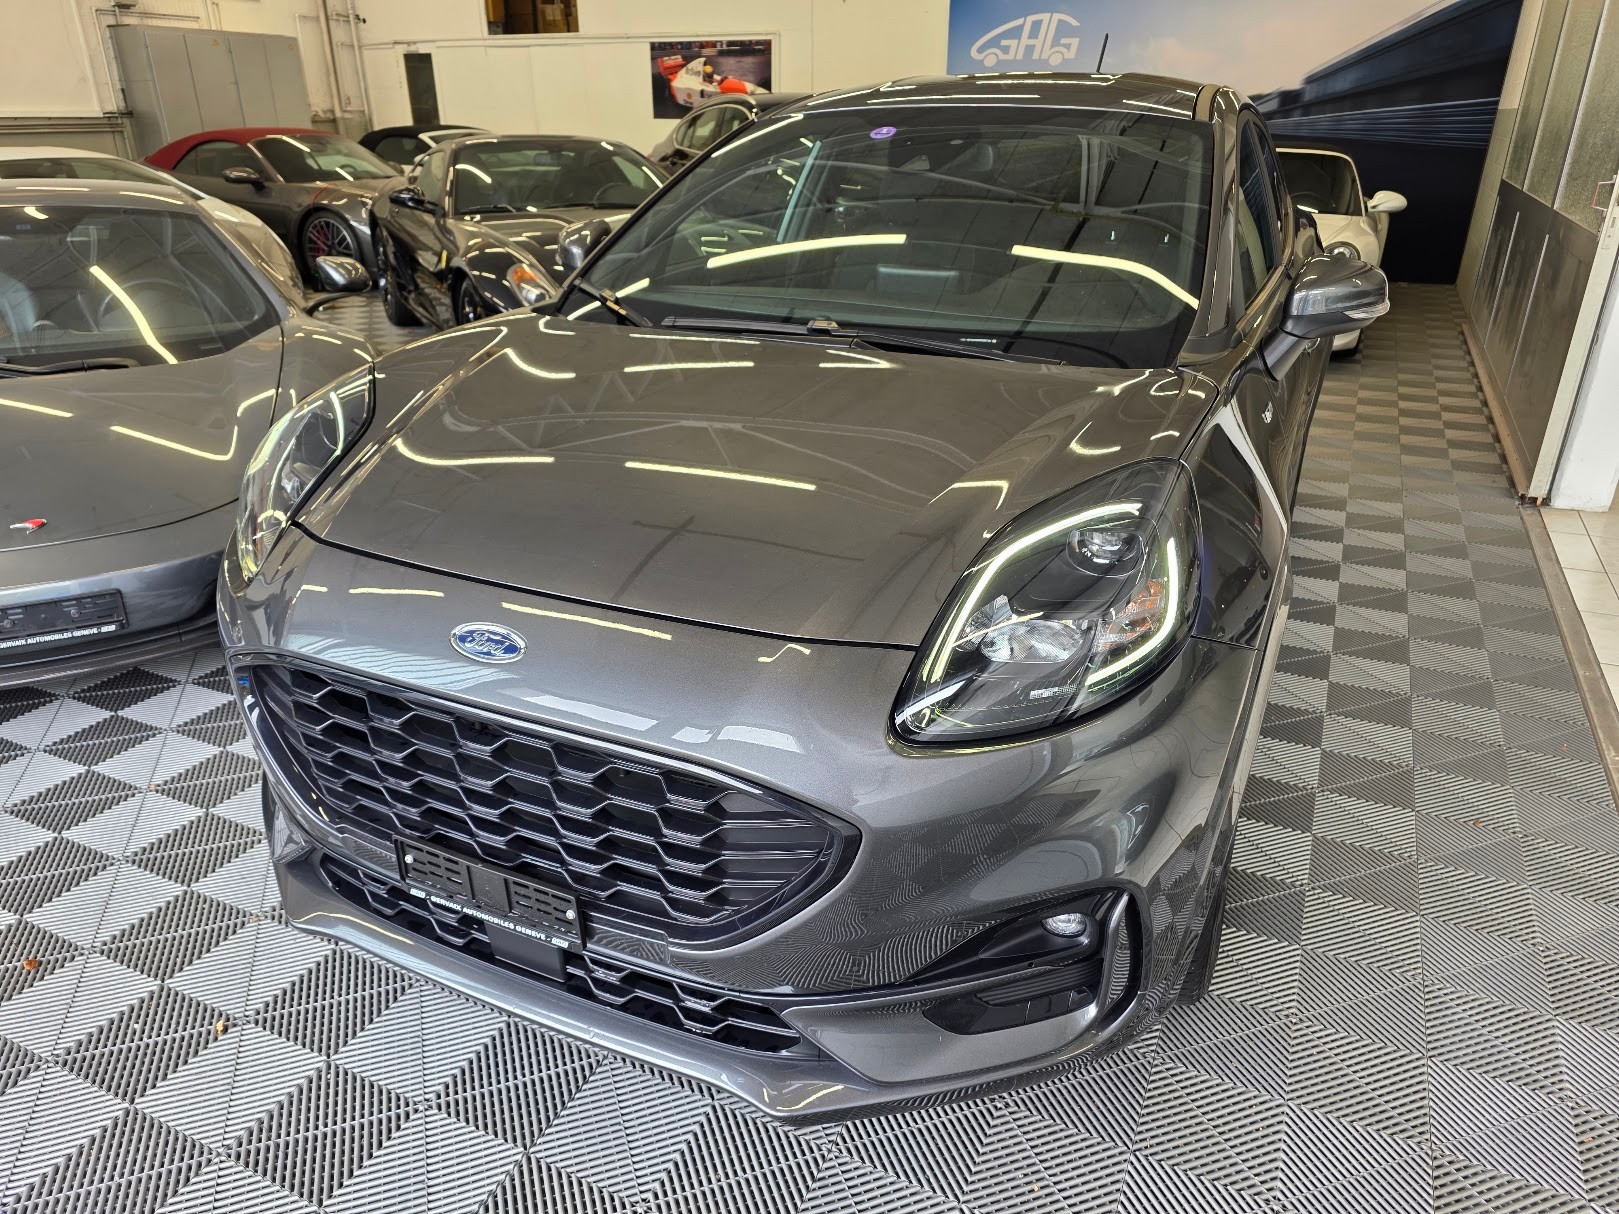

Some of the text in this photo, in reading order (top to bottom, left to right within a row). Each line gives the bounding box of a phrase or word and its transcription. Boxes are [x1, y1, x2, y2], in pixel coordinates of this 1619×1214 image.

[970, 12, 1080, 63] GAG
[27, 631, 72, 645] AUTOMOBILES
[465, 631, 510, 655] Ford
[430, 895, 462, 912] GERVAIX
[462, 907, 515, 930] AUTOMOBILES
[515, 925, 546, 941] GENEVE
